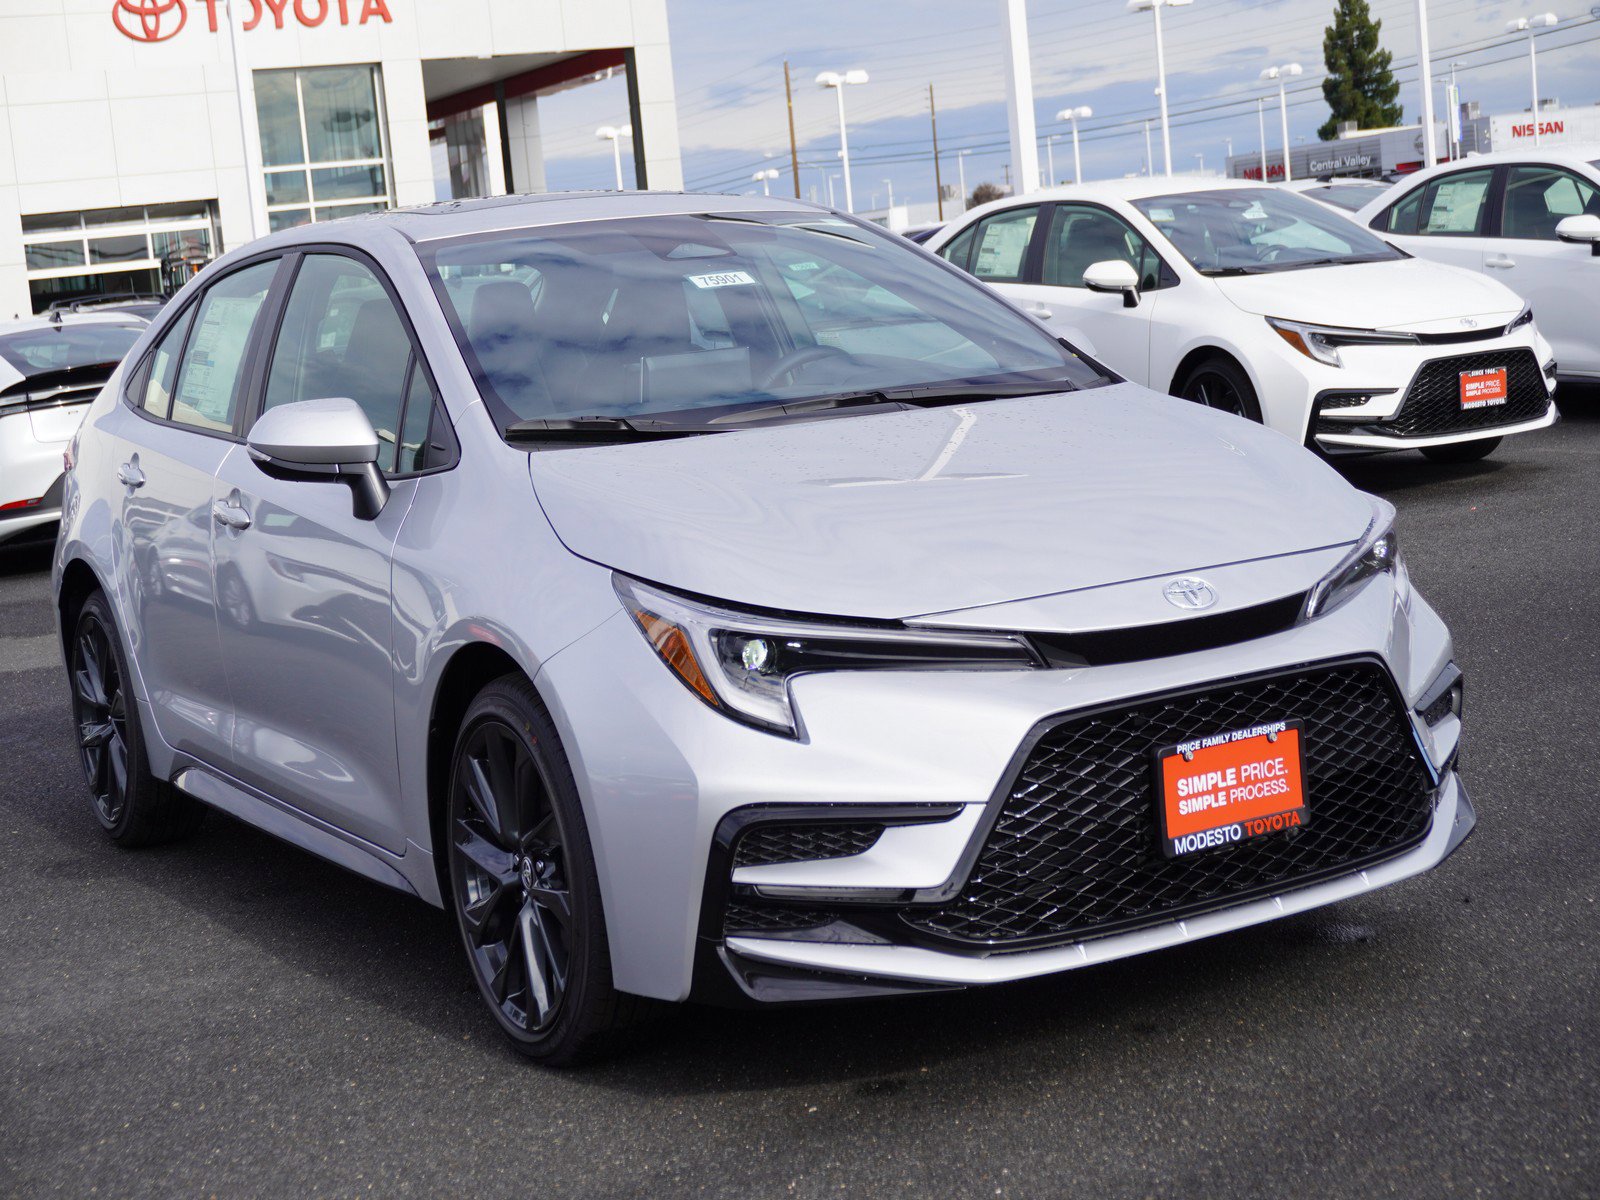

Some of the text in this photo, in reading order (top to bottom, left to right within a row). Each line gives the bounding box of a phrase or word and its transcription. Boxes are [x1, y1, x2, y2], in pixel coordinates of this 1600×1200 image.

[1511, 121, 1564, 138] NISSAN
[1310, 153, 1371, 171] Central Valley
[1243, 164, 1292, 180] NISSAN
[698, 273, 744, 286] 75901
[1465, 381, 1485, 390] SIMPLE
[1176, 722, 1286, 754] PRICE FAMILY DEALERSHIPS
[1177, 757, 1289, 797] SIMPLE PRICE.
[1178, 778, 1290, 815] SIMPLE PROCESS.
[1174, 811, 1301, 855] MODESTO TOYOTA
